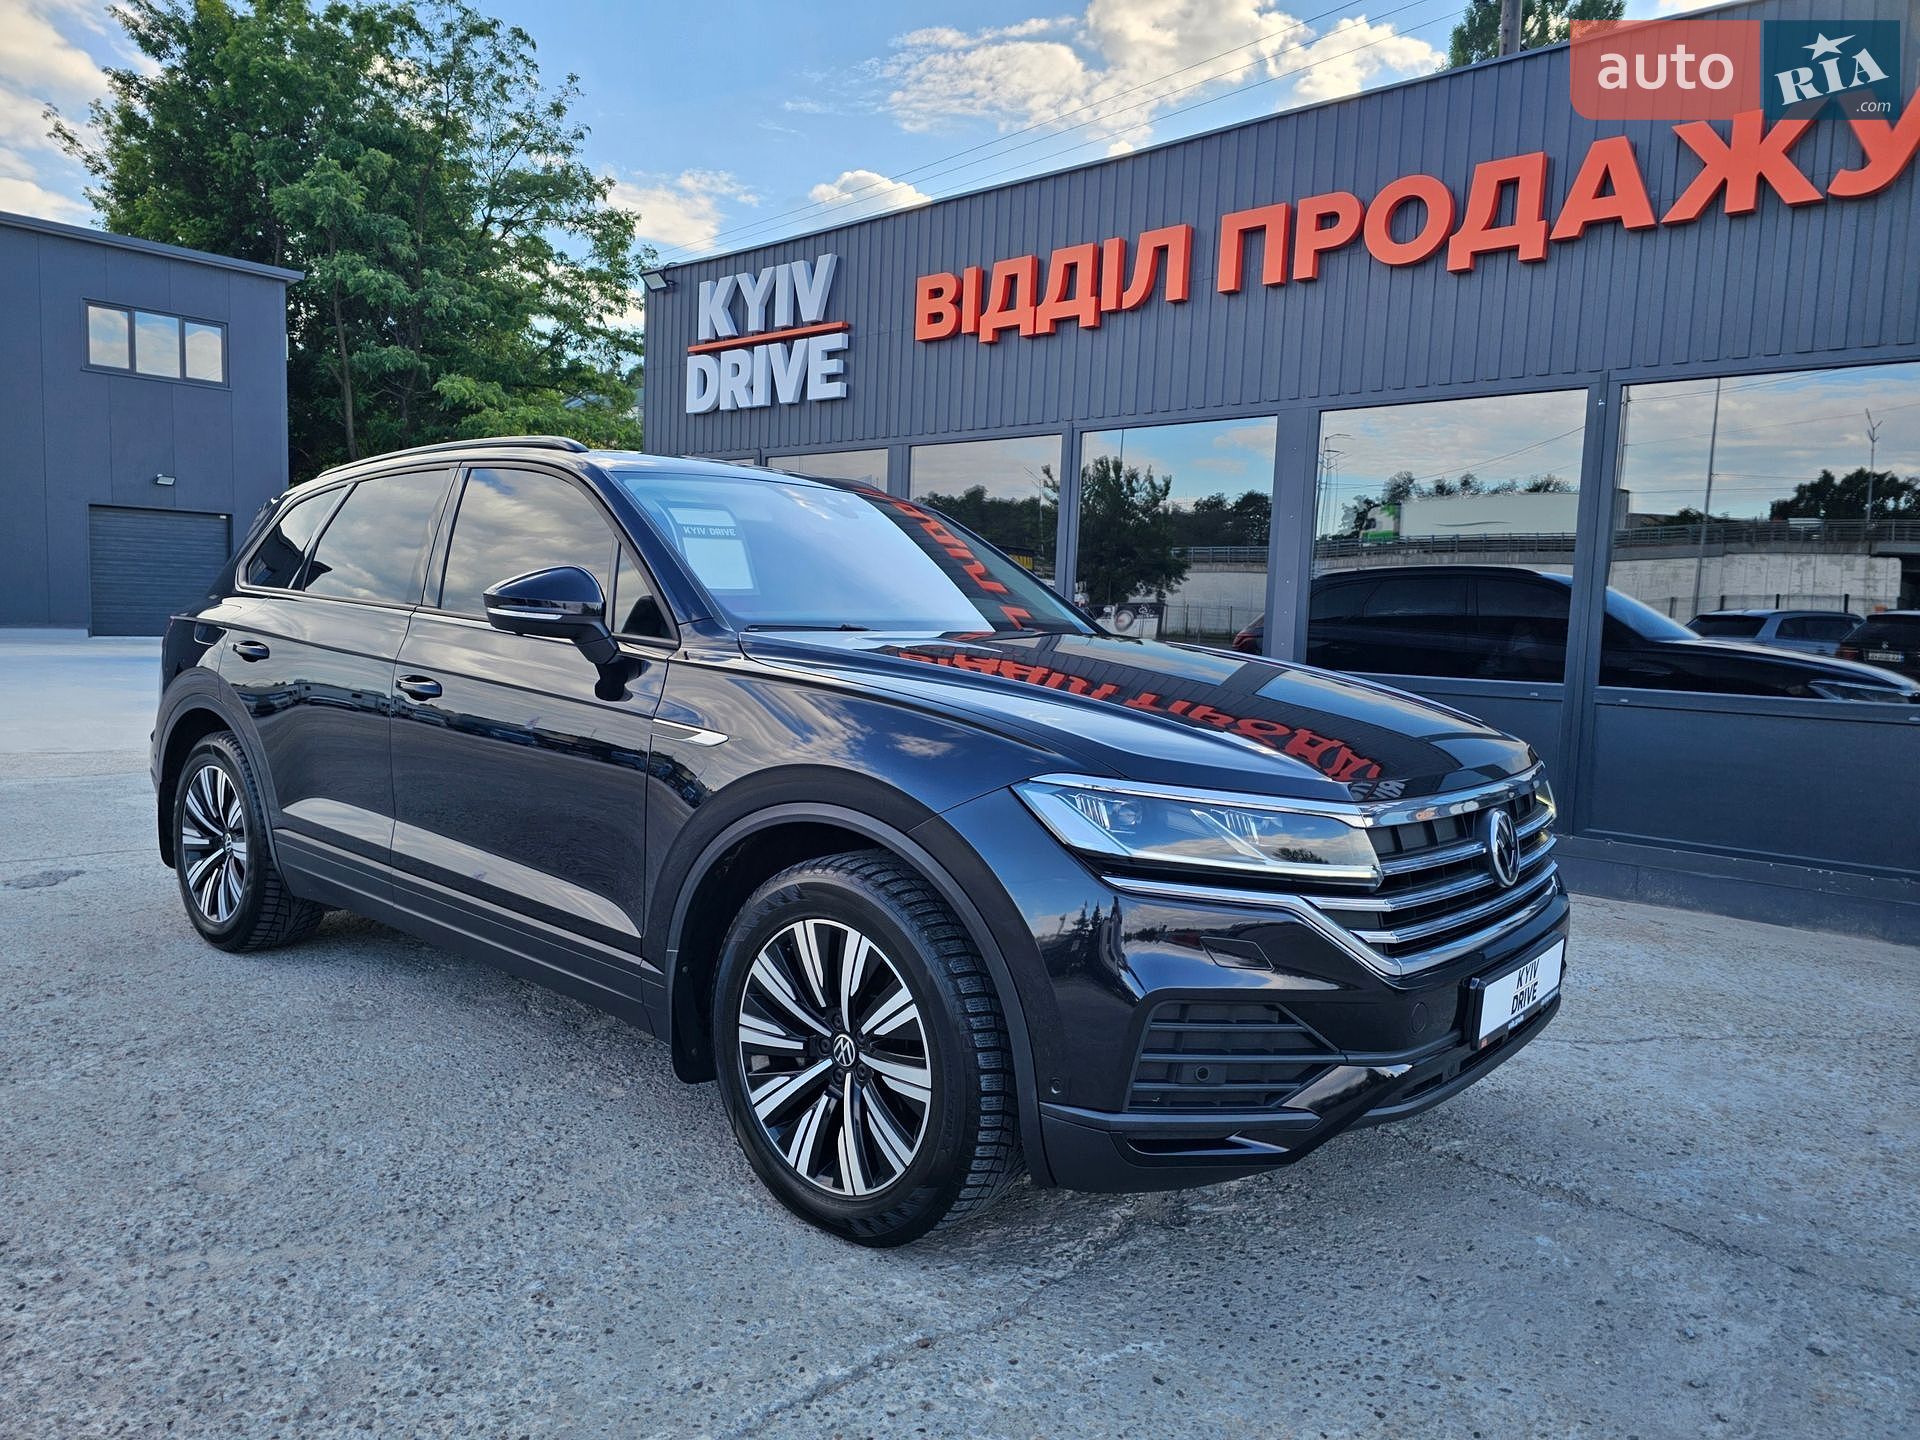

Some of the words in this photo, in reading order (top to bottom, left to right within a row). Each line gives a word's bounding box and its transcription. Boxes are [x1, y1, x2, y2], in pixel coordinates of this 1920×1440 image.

[915, 223, 1191, 343] ВІДДІЛ
[1217, 86, 1920, 294] ПРОДАЖУ
[697, 252, 839, 341] KYIV
[685, 333, 849, 415] DRIVE
[1510, 981, 1539, 1016] DRIVE
[1516, 958, 1540, 990] KYIV
